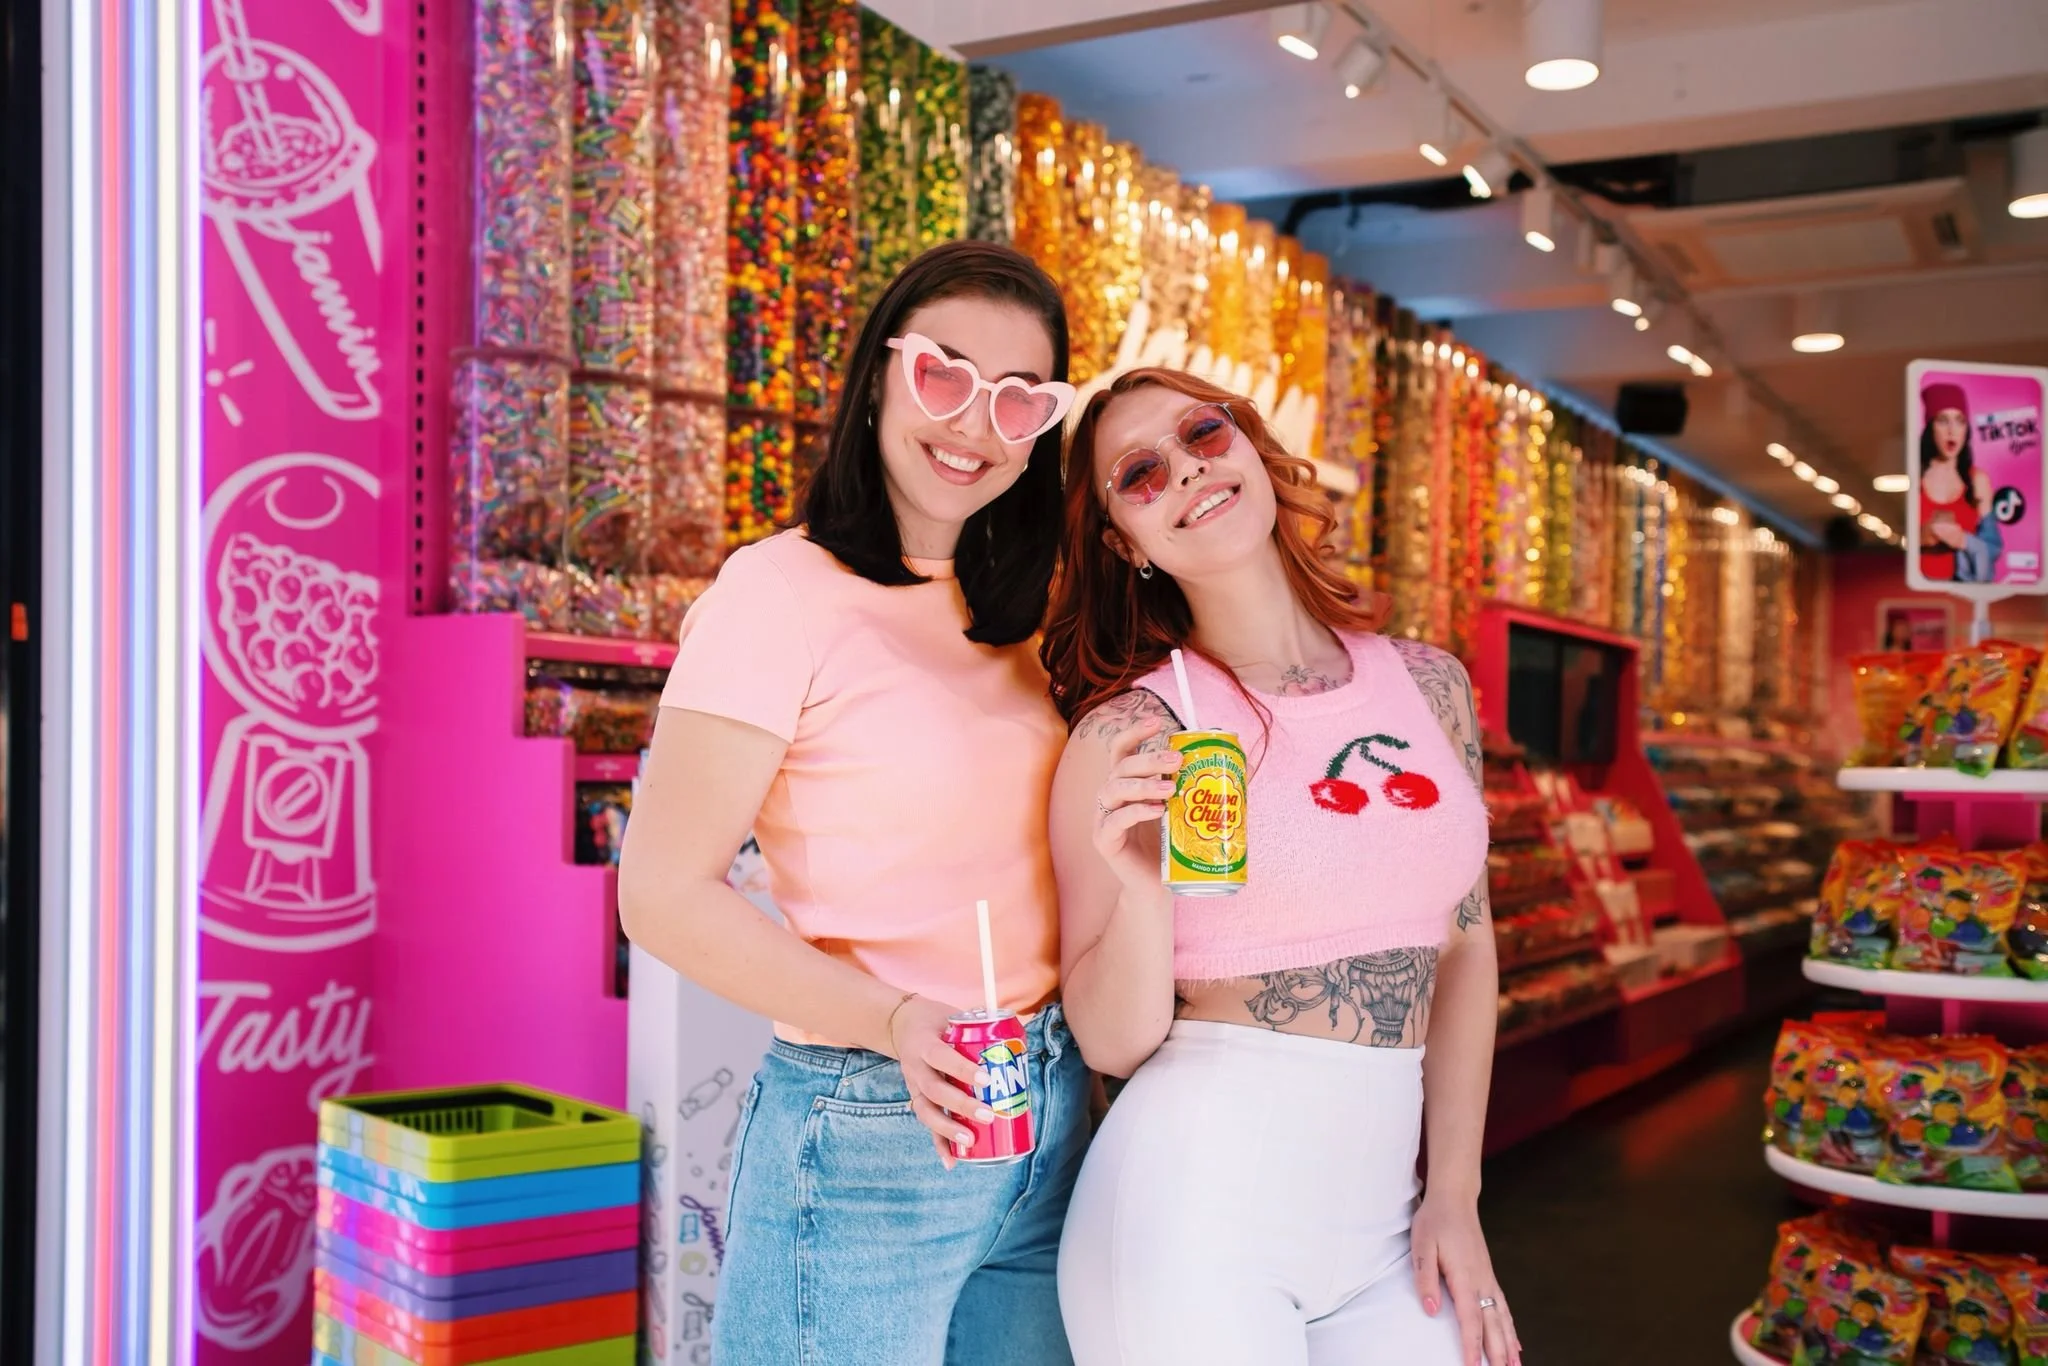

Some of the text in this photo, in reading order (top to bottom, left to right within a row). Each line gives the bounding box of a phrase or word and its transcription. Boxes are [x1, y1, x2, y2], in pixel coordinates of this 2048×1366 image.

[1977, 419, 2039, 443] TikTok
[1180, 752, 1246, 785] Sparkling
[1192, 788, 1239, 807] Chupa
[1189, 805, 1237, 832] Chups
[1191, 862, 1211, 872] MANGO
[197, 979, 376, 1112] Tasty
